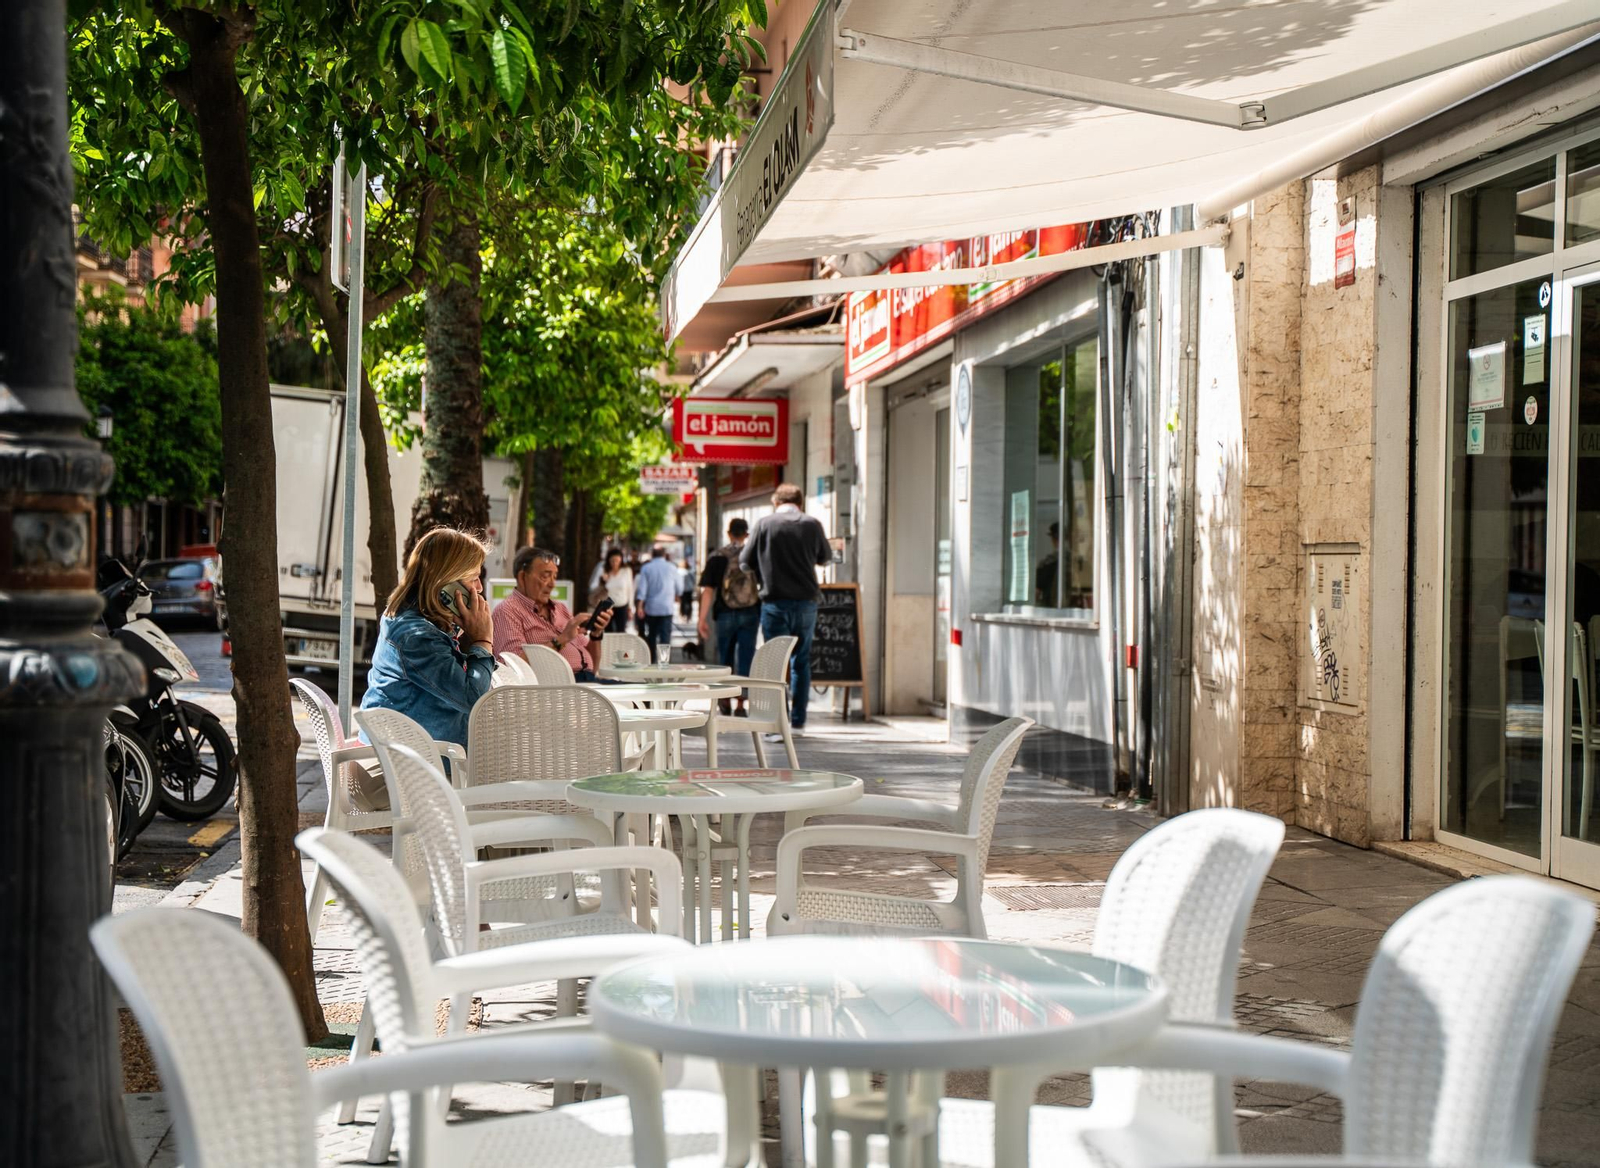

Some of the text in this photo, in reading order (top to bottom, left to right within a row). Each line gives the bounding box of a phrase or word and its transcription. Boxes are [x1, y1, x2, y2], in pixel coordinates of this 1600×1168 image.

[689, 414, 771, 436] el jamón
[645, 467, 689, 478] BAZAR
